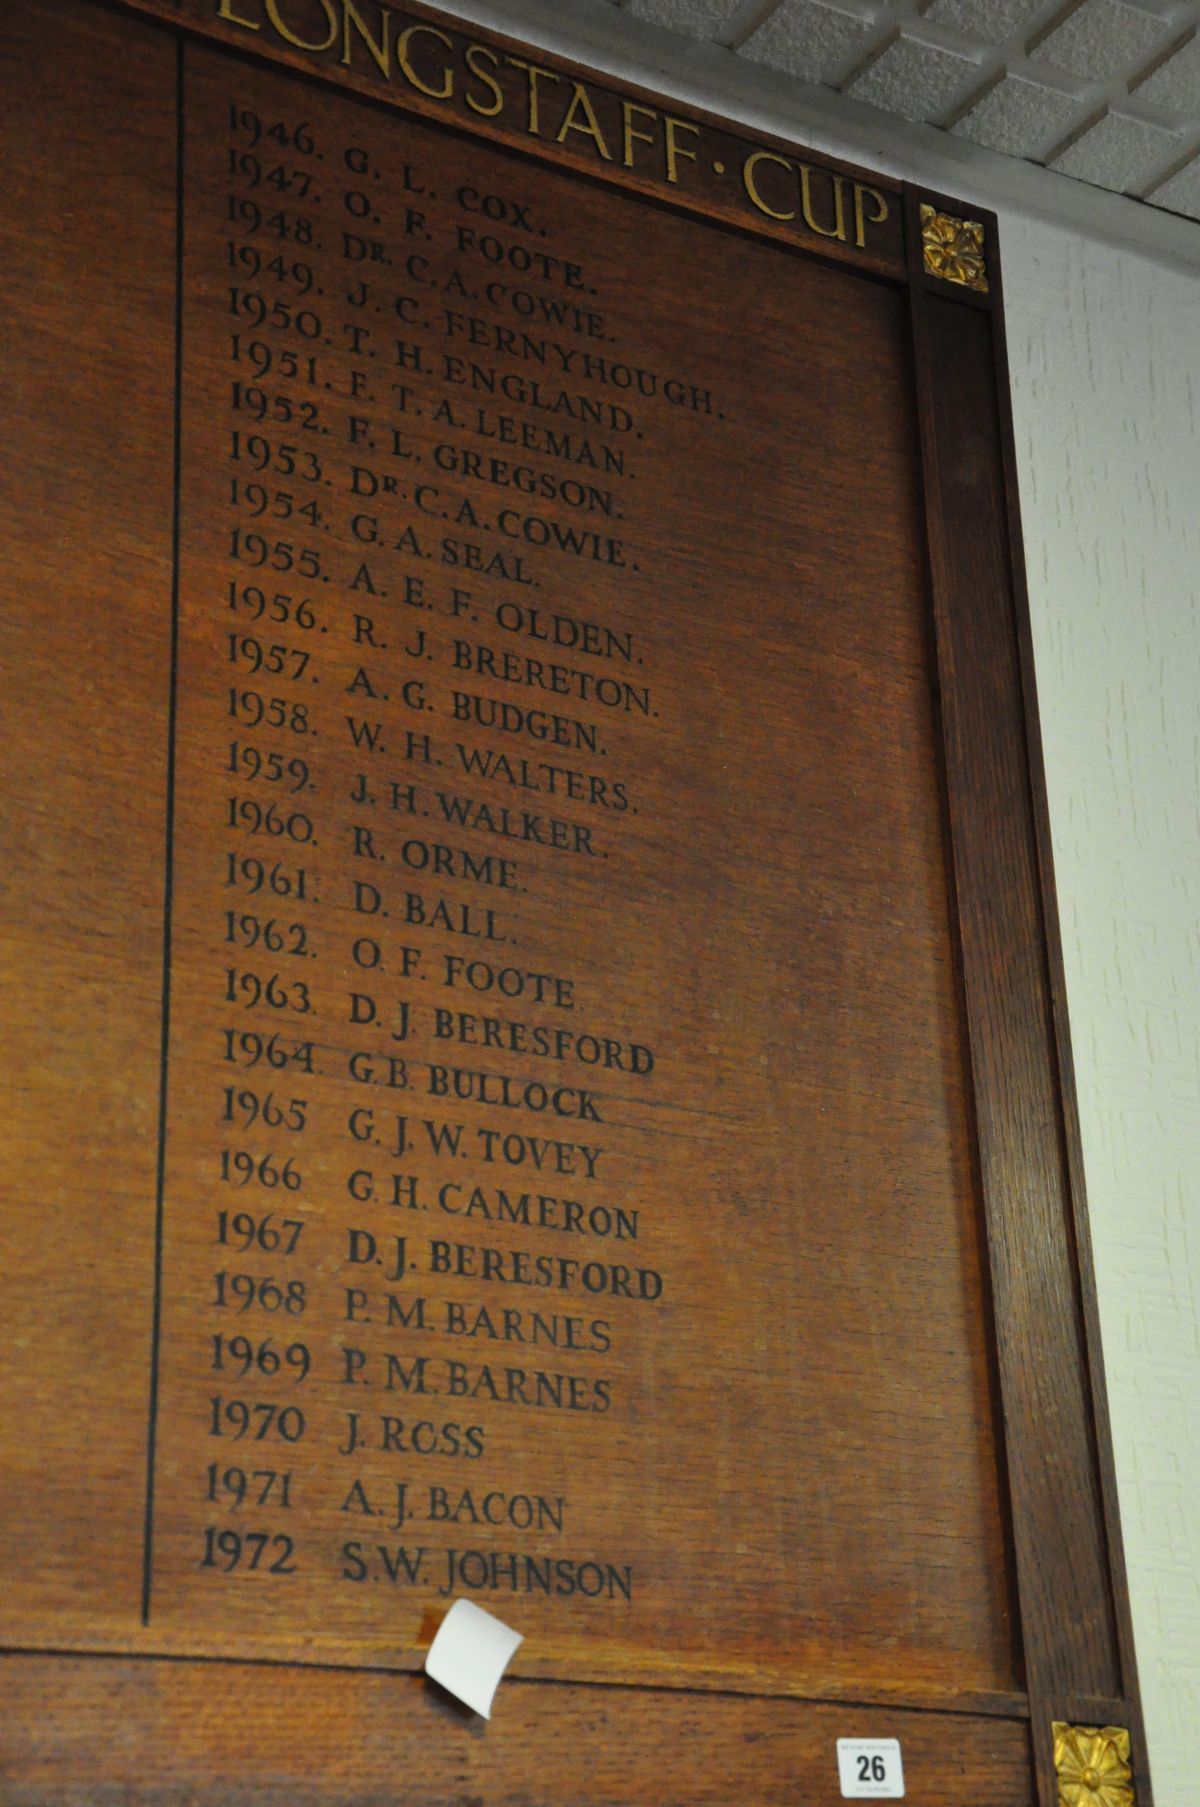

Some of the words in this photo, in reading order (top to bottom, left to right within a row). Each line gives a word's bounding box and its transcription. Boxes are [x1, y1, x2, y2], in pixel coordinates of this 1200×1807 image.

[229, 105, 324, 160] 1946.
[454, 185, 548, 237] COX.
[743, 152, 889, 247] CUP
[227, 149, 321, 204] 1947.
[456, 225, 598, 295] FOOTE.
[227, 194, 322, 250] 1948.
[227, 287, 332, 345] 1950.
[443, 354, 643, 439] ENGLAND.
[228, 241, 324, 296] 1949.
[444, 310, 725, 419] FERNYHOUGH.
[230, 334, 333, 391] 1951.
[475, 409, 635, 479] LEEMAN.
[231, 381, 330, 435] 1952.
[433, 444, 625, 520] GREGSON.
[230, 431, 332, 486] 1953.
[497, 509, 643, 571] COWIE.
[230, 477, 330, 531] 1954.
[441, 538, 540, 588] SEAL.
[229, 527, 330, 583] 1955.
[496, 603, 643, 665] OLDEN.
[228, 633, 319, 683] 1957.
[451, 691, 606, 755] BUDGEN.
[229, 582, 328, 633] 1956.
[452, 639, 659, 717] BRERETON.
[228, 688, 317, 736] 1958.
[455, 743, 638, 814] WALTERS.
[226, 741, 315, 793] 1959.
[435, 792, 608, 858] WALKER.
[226, 796, 317, 846] 1960.
[402, 840, 528, 893] ORME.
[225, 911, 317, 958] 1962.
[226, 852, 319, 903] 1961.
[403, 892, 517, 945] BALL.
[434, 1008, 654, 1077] BERESFORD
[222, 1086, 307, 1132] 1965
[477, 1128, 604, 1179] TOVEY
[425, 1064, 604, 1123] BULLOCK
[221, 1149, 302, 1191] 1966
[438, 1183, 639, 1240] CAMERON
[217, 1210, 304, 1255] 1967
[429, 1240, 662, 1300] BERESFORD
[212, 1271, 306, 1314] 1968
[445, 1302, 610, 1353] BARNES
[210, 1396, 305, 1442] 1970
[212, 1334, 311, 1383] 1969
[446, 1359, 610, 1413] BARNES
[205, 1462, 291, 1508] 1971
[427, 1487, 565, 1531] BACON
[200, 1526, 297, 1574] 1972
[439, 1549, 632, 1601] JOHNSON
[856, 1755, 886, 1782] 26
